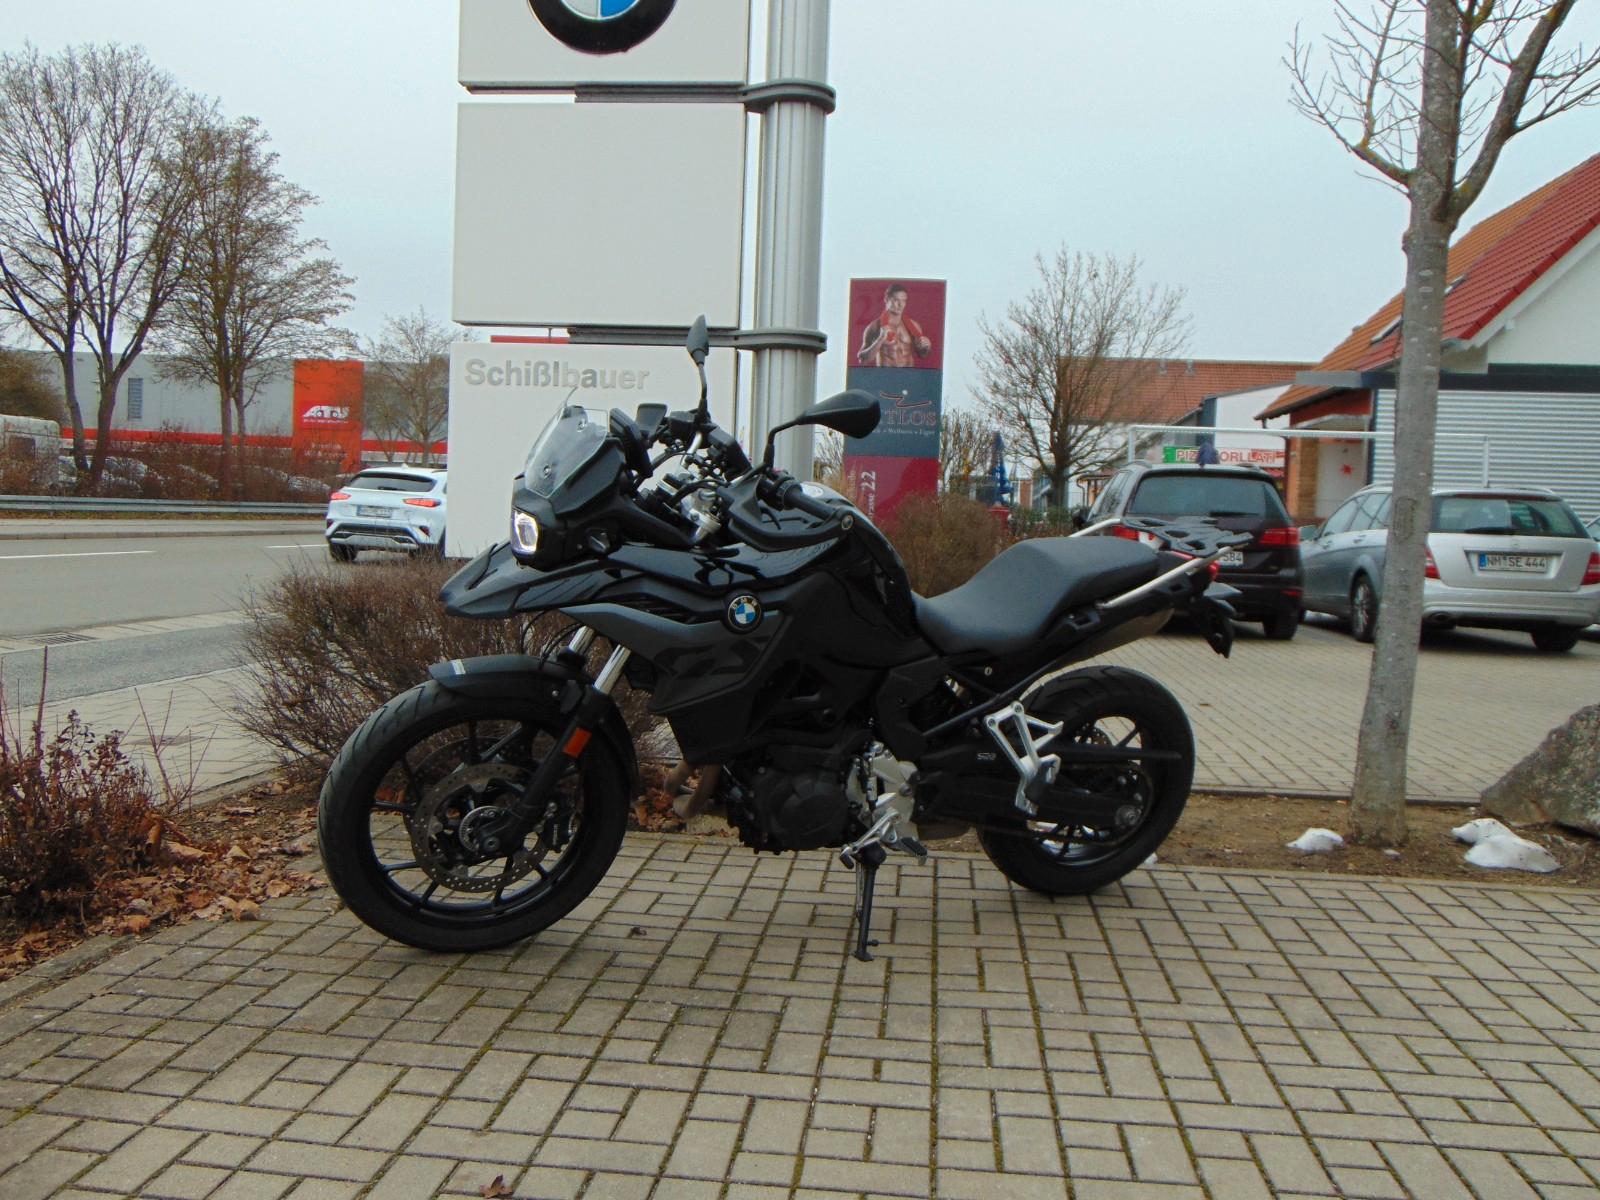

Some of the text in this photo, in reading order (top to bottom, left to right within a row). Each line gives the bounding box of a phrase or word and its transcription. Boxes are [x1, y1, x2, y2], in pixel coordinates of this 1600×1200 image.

[464, 358, 650, 390] Schißlbauer
[1176, 449, 1200, 463] PIZ
[860, 471, 876, 490] 22
